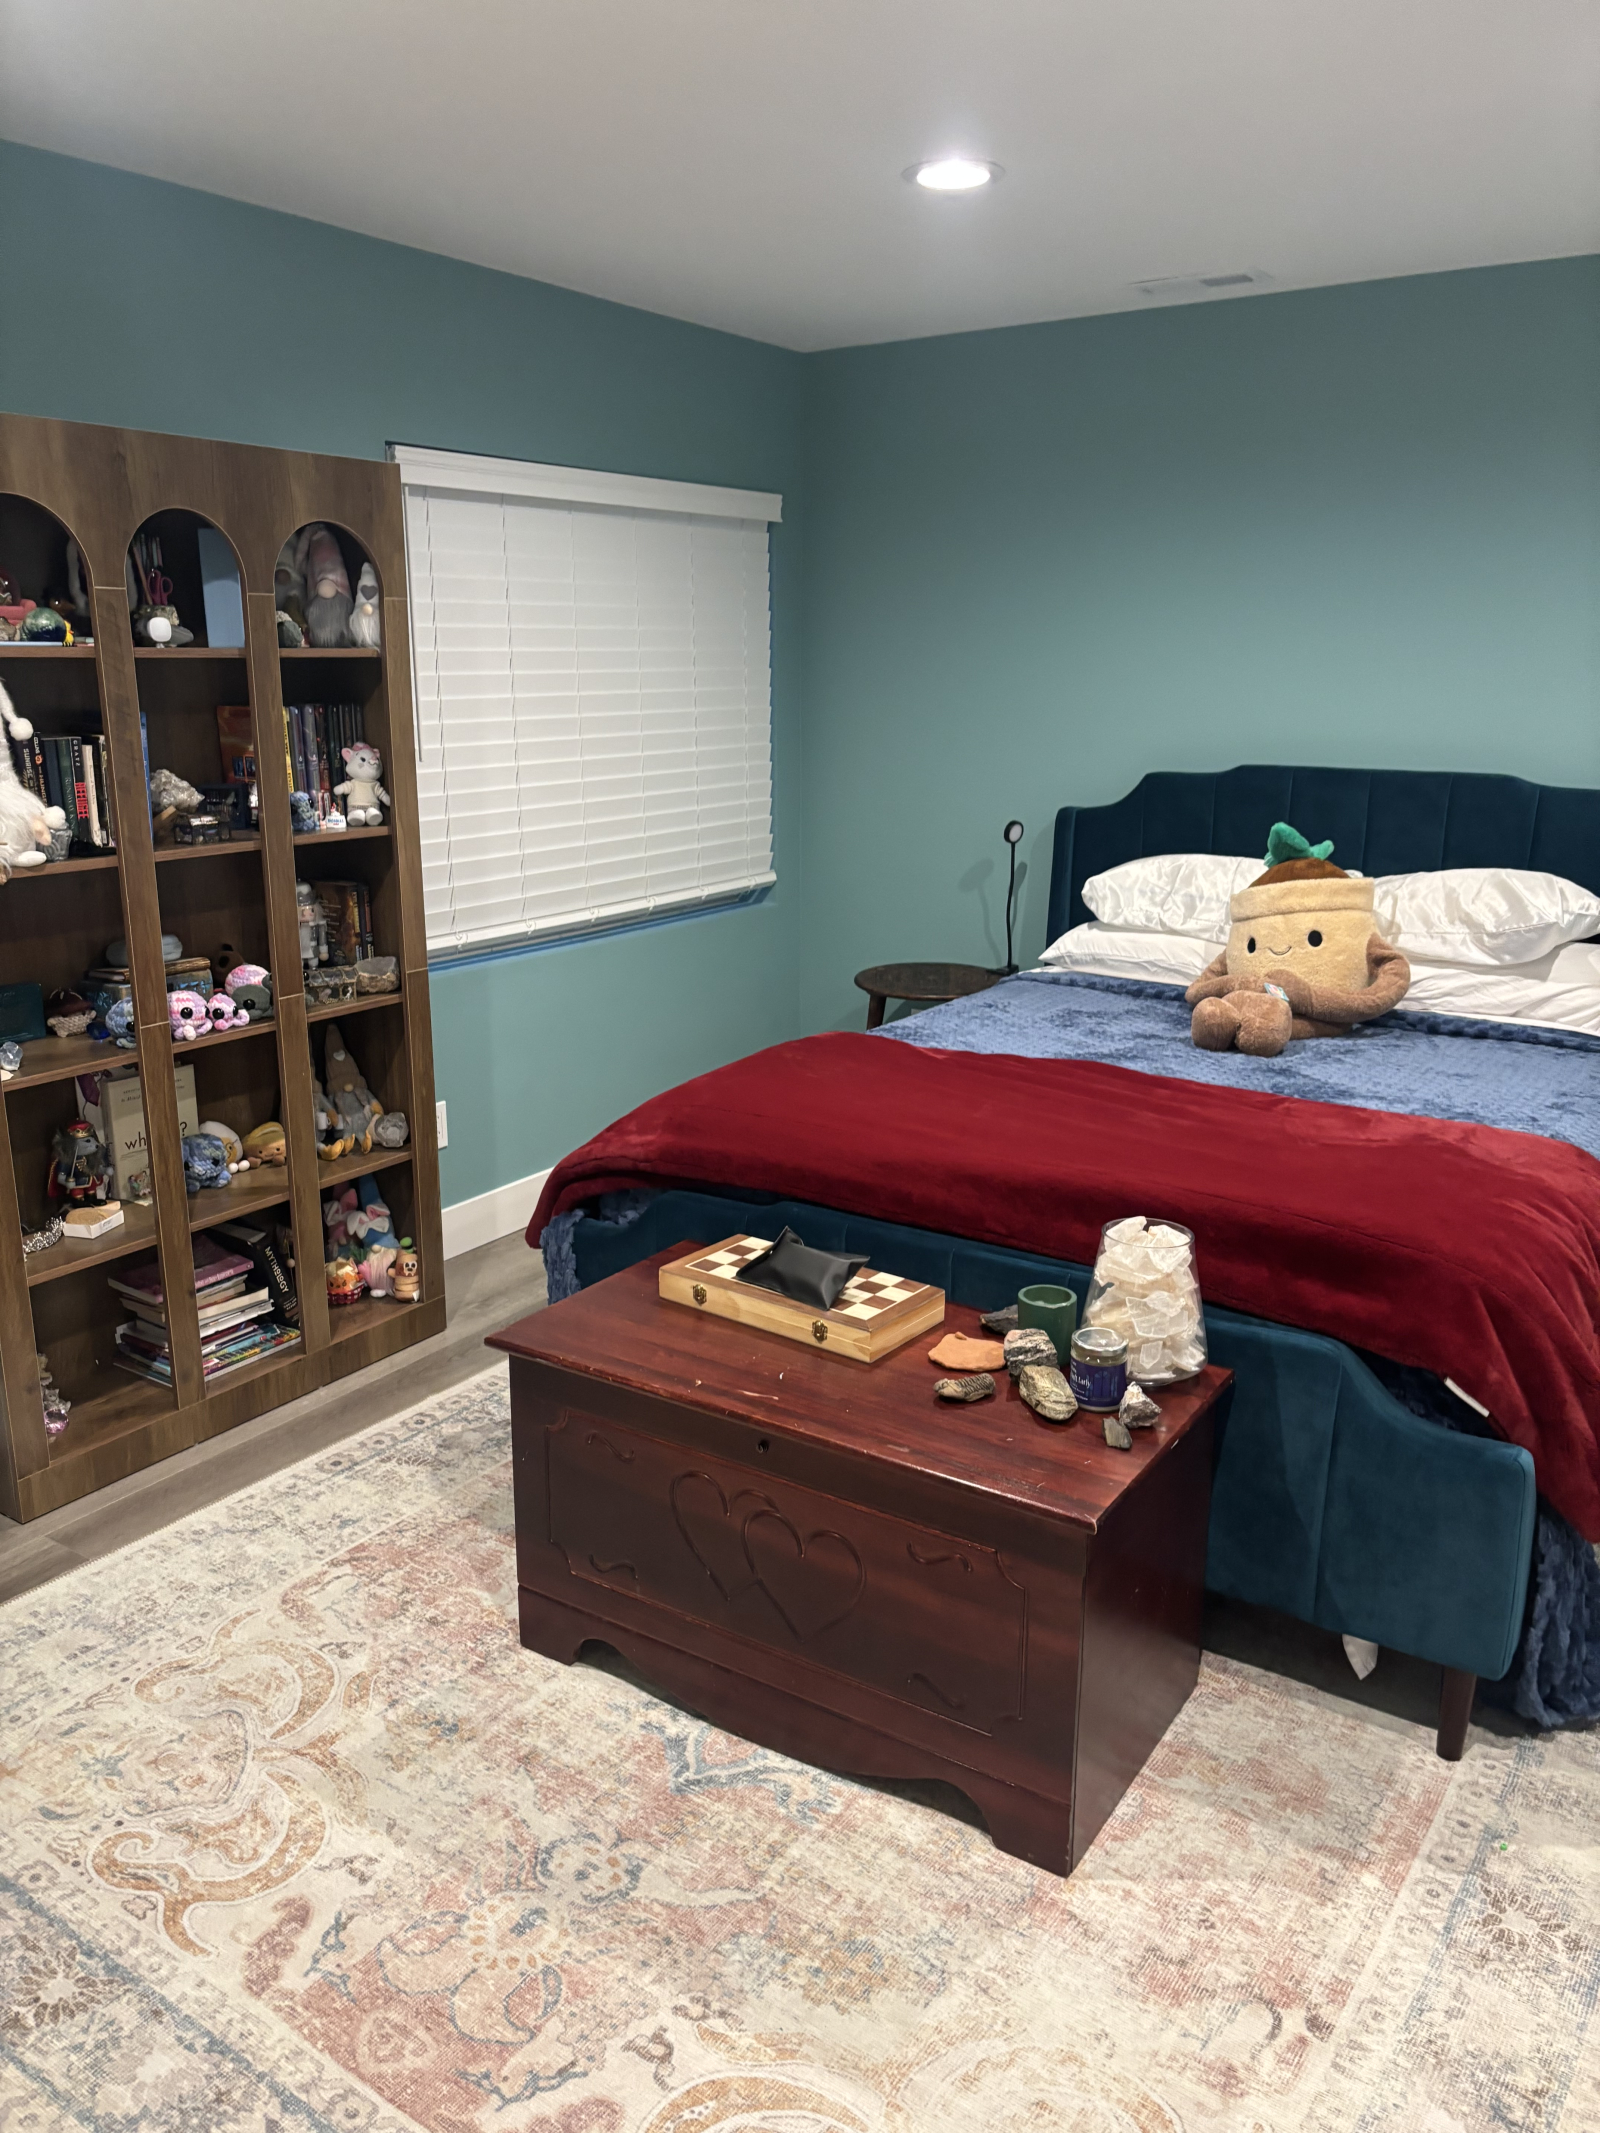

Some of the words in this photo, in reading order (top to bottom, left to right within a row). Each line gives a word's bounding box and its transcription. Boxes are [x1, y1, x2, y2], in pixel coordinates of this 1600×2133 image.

[23, 748, 33, 779] SUNRISE
[73, 739, 81, 766] GRATZ
[75, 782, 89, 819] REFUGEE
[124, 1131, 147, 1150] wh
[265, 1246, 289, 1293] MYTHOLOGY
